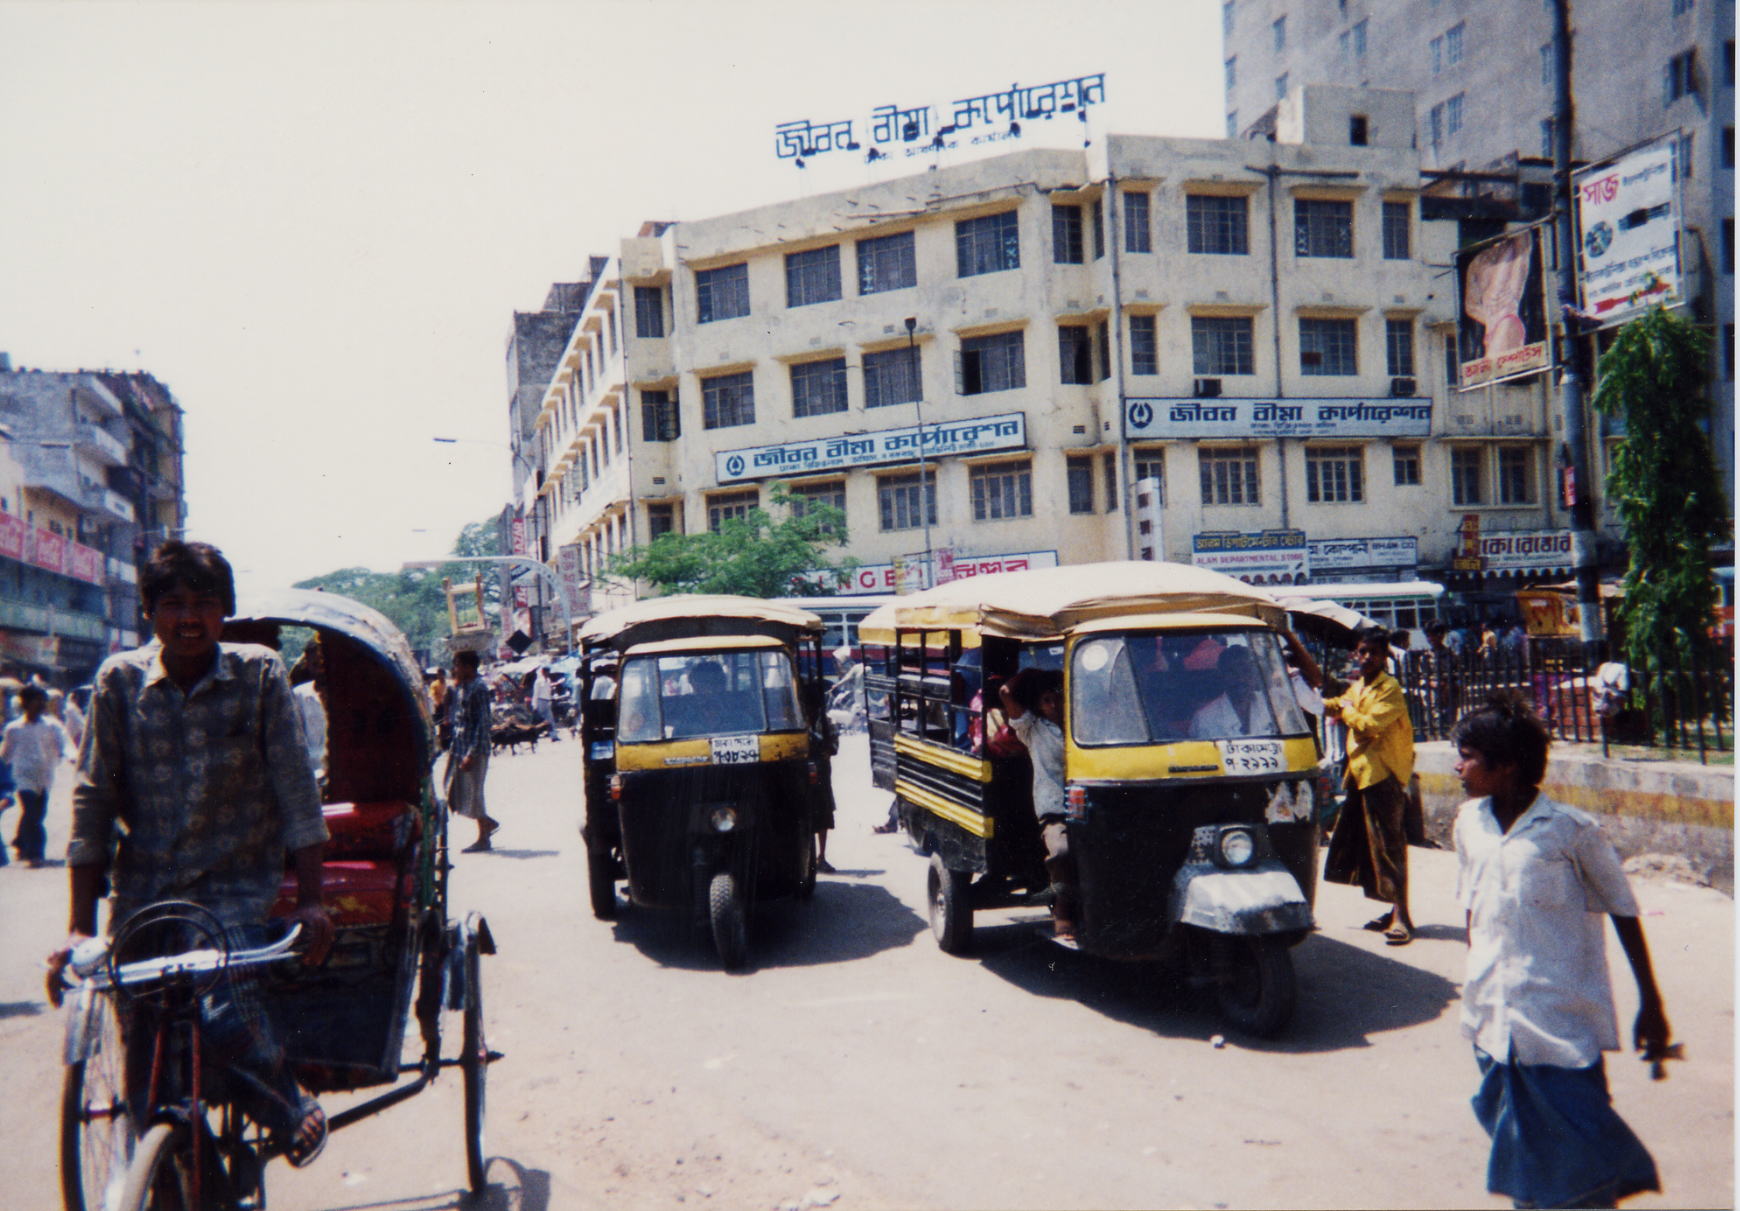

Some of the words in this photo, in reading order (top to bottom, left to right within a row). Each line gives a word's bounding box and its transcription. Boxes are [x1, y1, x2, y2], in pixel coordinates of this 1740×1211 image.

[775, 119, 856, 159] জীবন
[873, 104, 931, 143] বীমা
[1169, 402, 1237, 422] জীবন
[1253, 402, 1303, 422] বীমা
[754, 446, 818, 468] জীবন
[826, 437, 875, 460] বীমা
